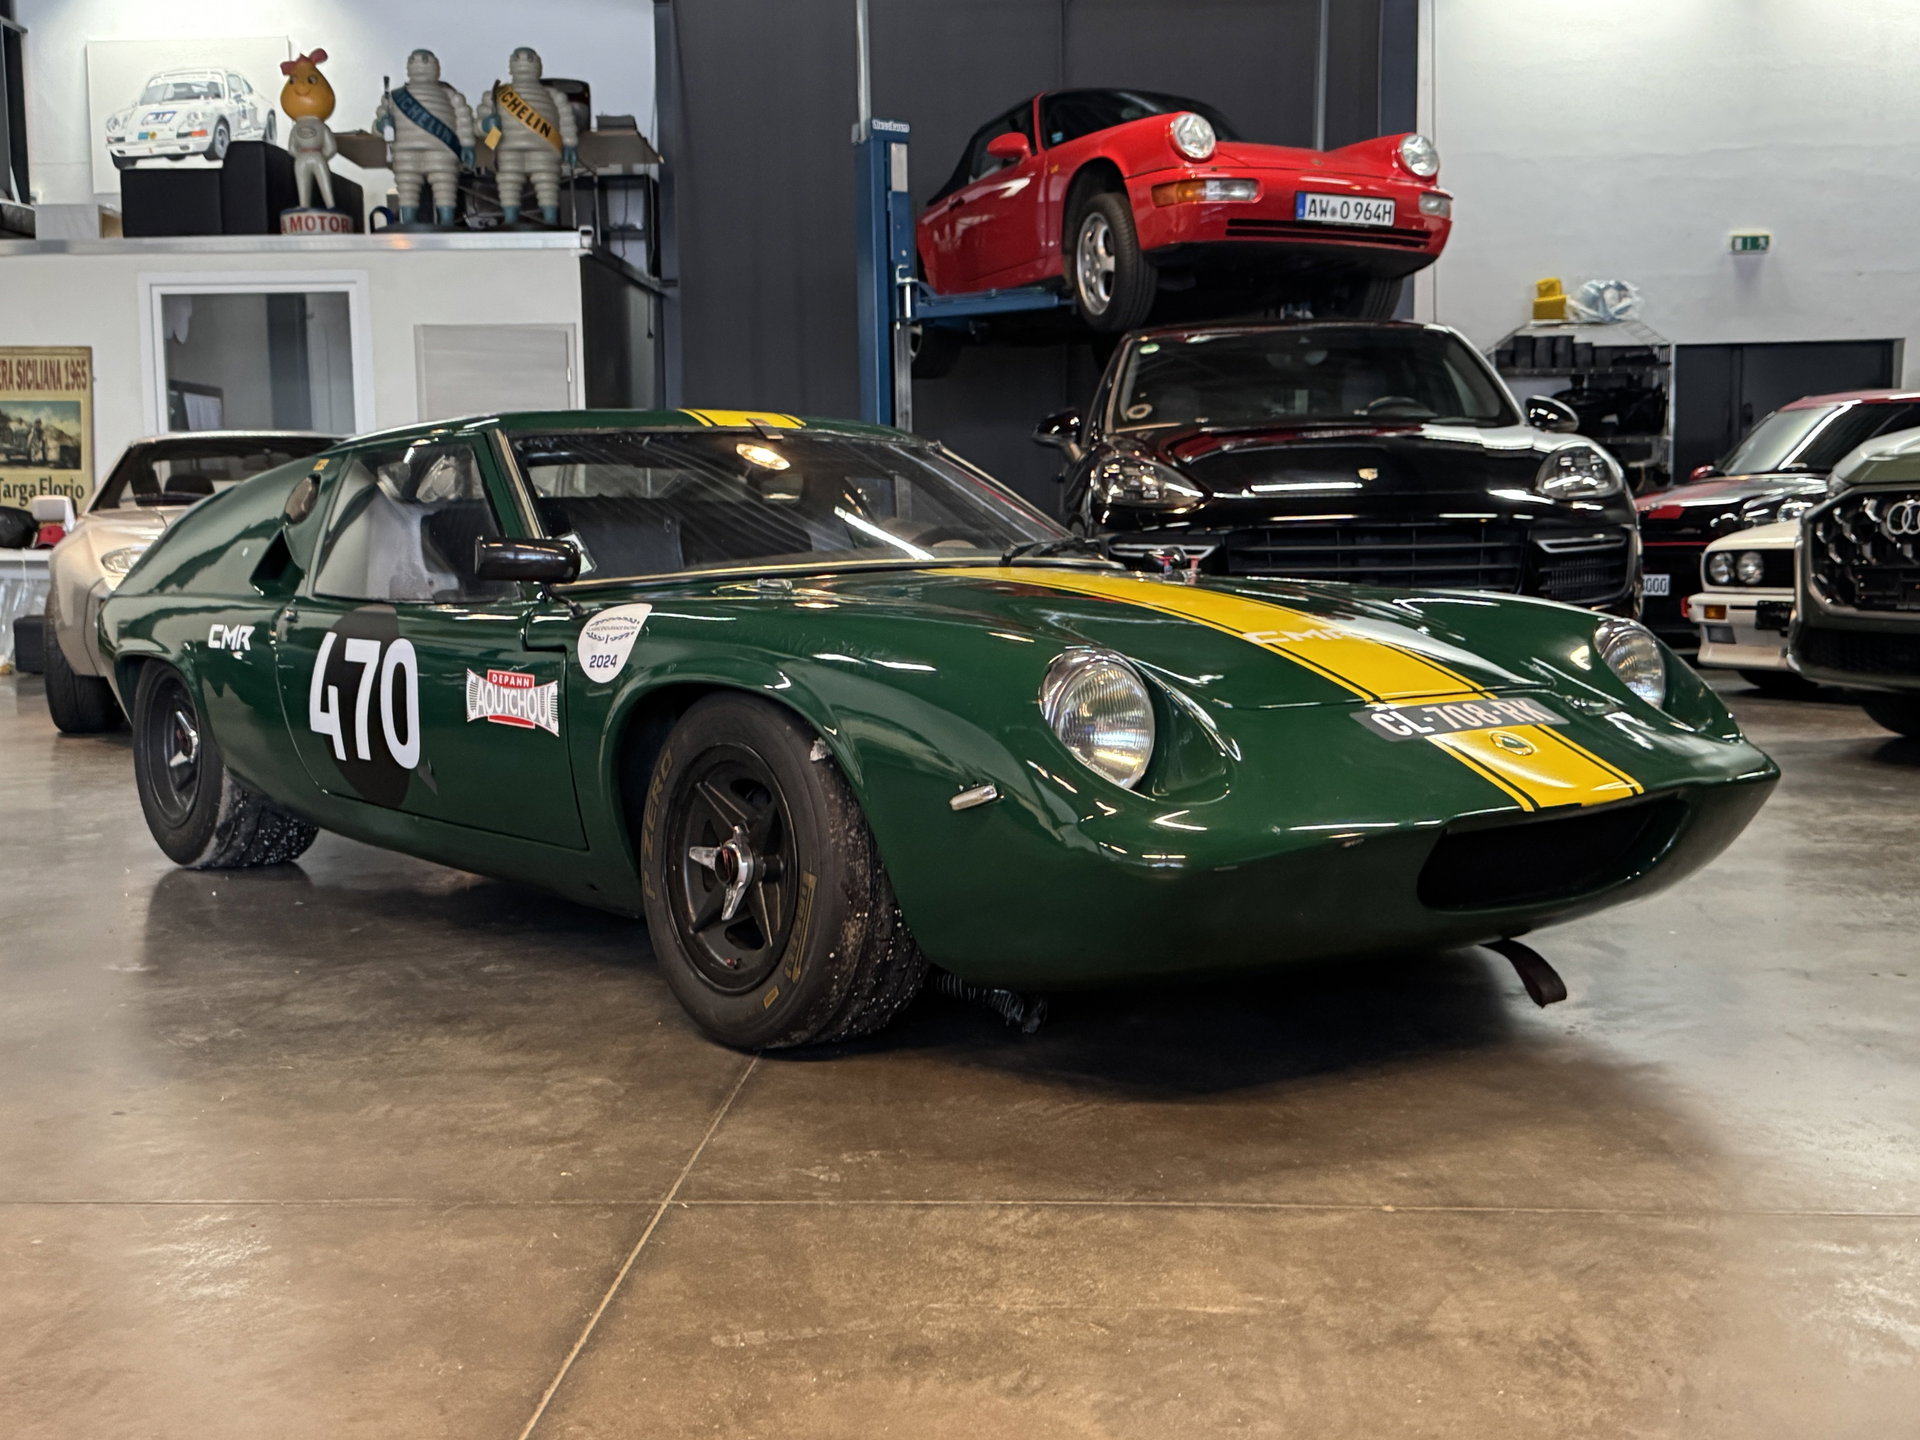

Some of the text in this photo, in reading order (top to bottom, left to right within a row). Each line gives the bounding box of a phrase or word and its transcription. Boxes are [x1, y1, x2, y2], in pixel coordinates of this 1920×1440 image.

[1307, 198, 1330, 218] AW
[1354, 202, 1393, 223] 964H
[16, 359, 62, 391] SICILIANA
[64, 359, 88, 391] 1965
[207, 624, 255, 651] CMR
[589, 654, 618, 669] 2024
[492, 673, 530, 688] DEPANN
[308, 631, 420, 770] 470
[466, 673, 560, 735] CAOUTCHOUC
